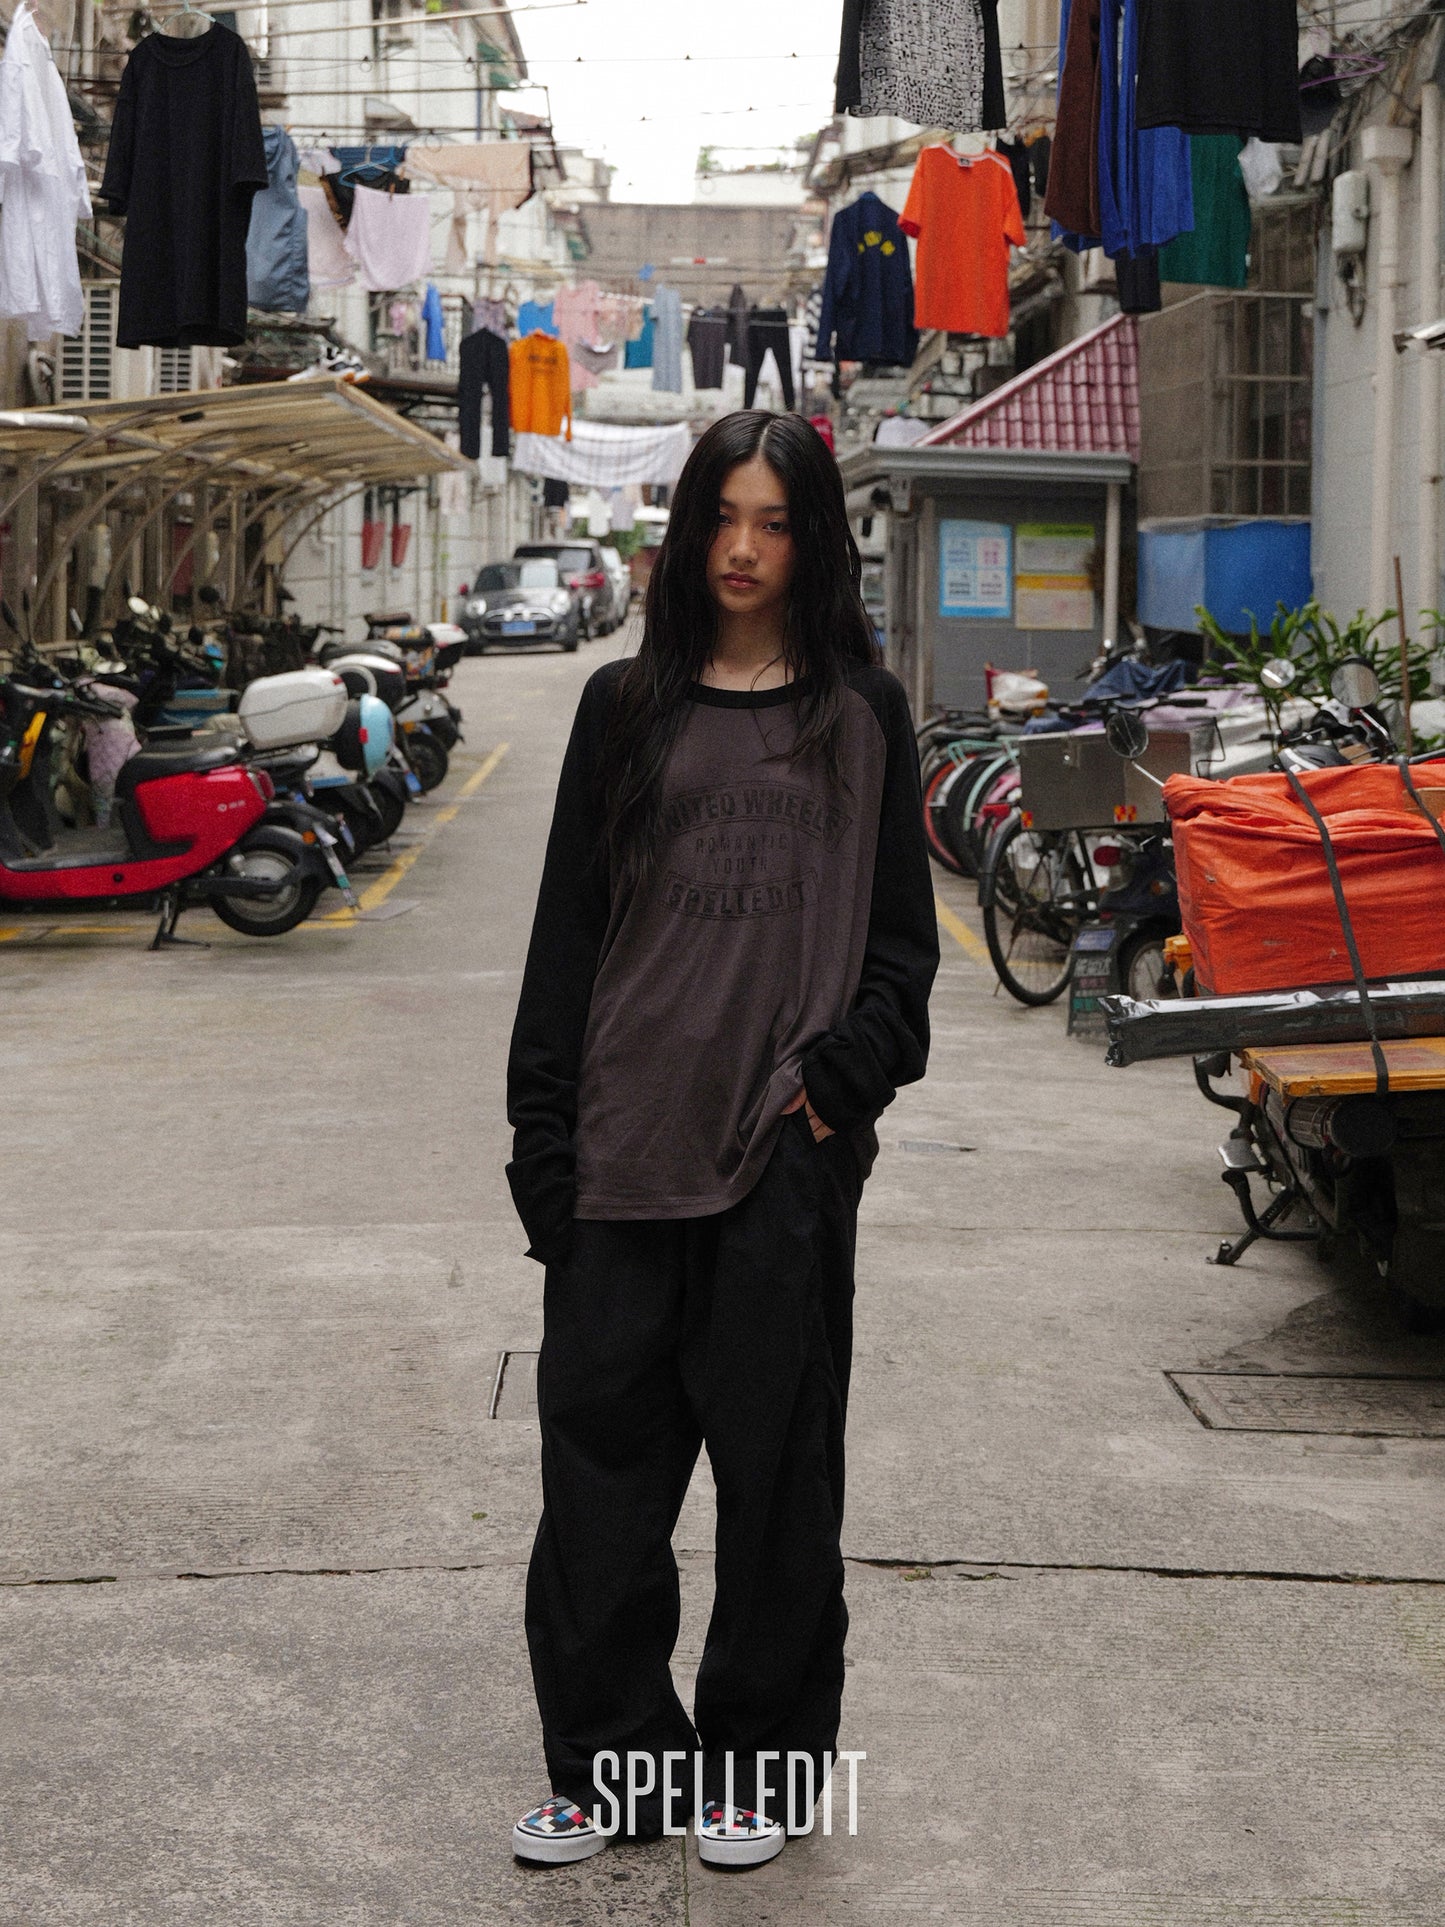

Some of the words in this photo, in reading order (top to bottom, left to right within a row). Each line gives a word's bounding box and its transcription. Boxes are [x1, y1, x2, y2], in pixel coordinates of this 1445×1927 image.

[696, 832, 789, 854] ROMANTIC
[712, 856, 768, 875] YOUTH
[669, 881, 805, 914] SPELLEDIT
